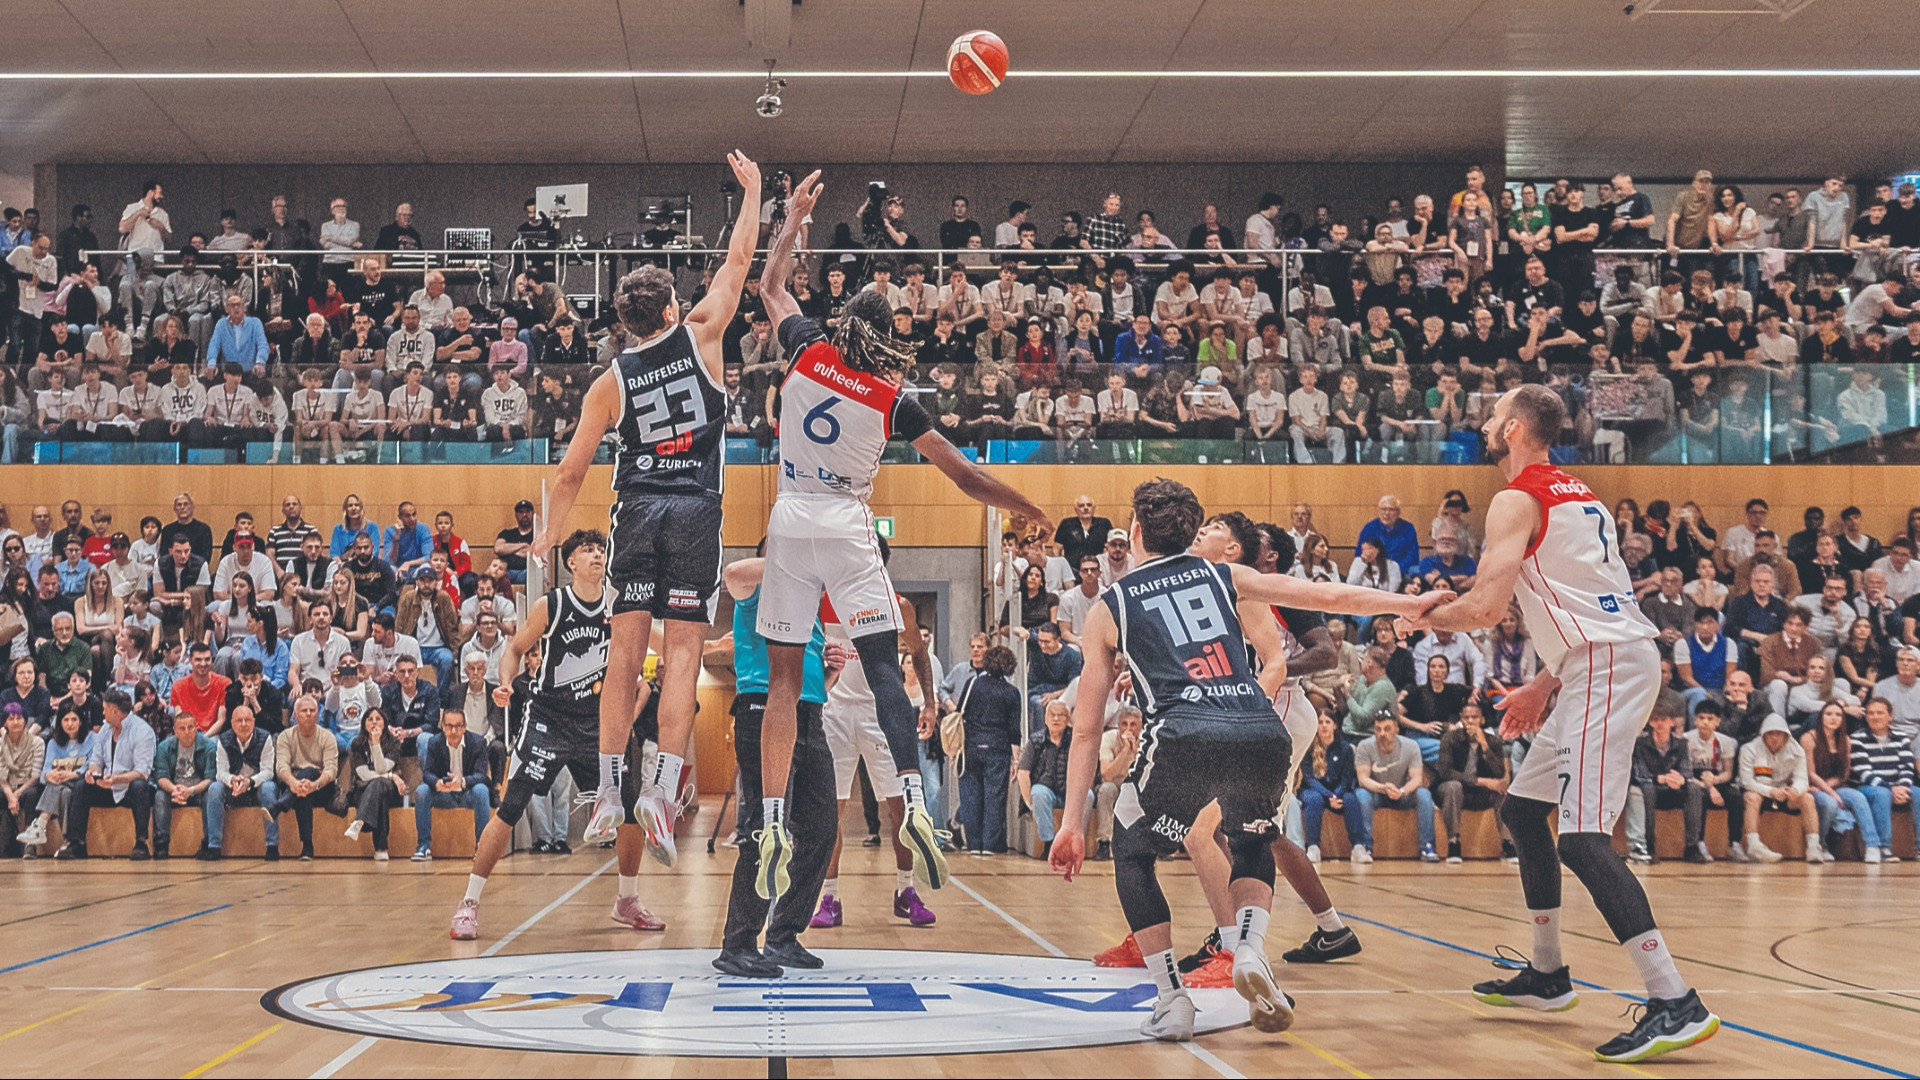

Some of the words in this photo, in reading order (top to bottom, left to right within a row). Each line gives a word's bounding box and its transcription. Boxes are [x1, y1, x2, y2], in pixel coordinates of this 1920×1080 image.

[628, 357, 694, 390] RAIFFEISEN
[814, 362, 872, 395] wheeler
[632, 375, 708, 443] 23
[803, 395, 842, 444] 6
[1582, 506, 1609, 563] 7
[626, 582, 655, 592] AIMO
[1128, 568, 1211, 597] RAIFFEISEN
[856, 608, 879, 618] ENNIO
[858, 614, 888, 626] FERRARI
[1141, 583, 1229, 647] 18
[561, 626, 600, 644] LUGANO
[1184, 641, 1233, 680] ail
[571, 670, 603, 691] Lugano's
[575, 688, 592, 700] Plan
[1204, 682, 1254, 697] ZURICH
[1558, 773, 1571, 805] 7
